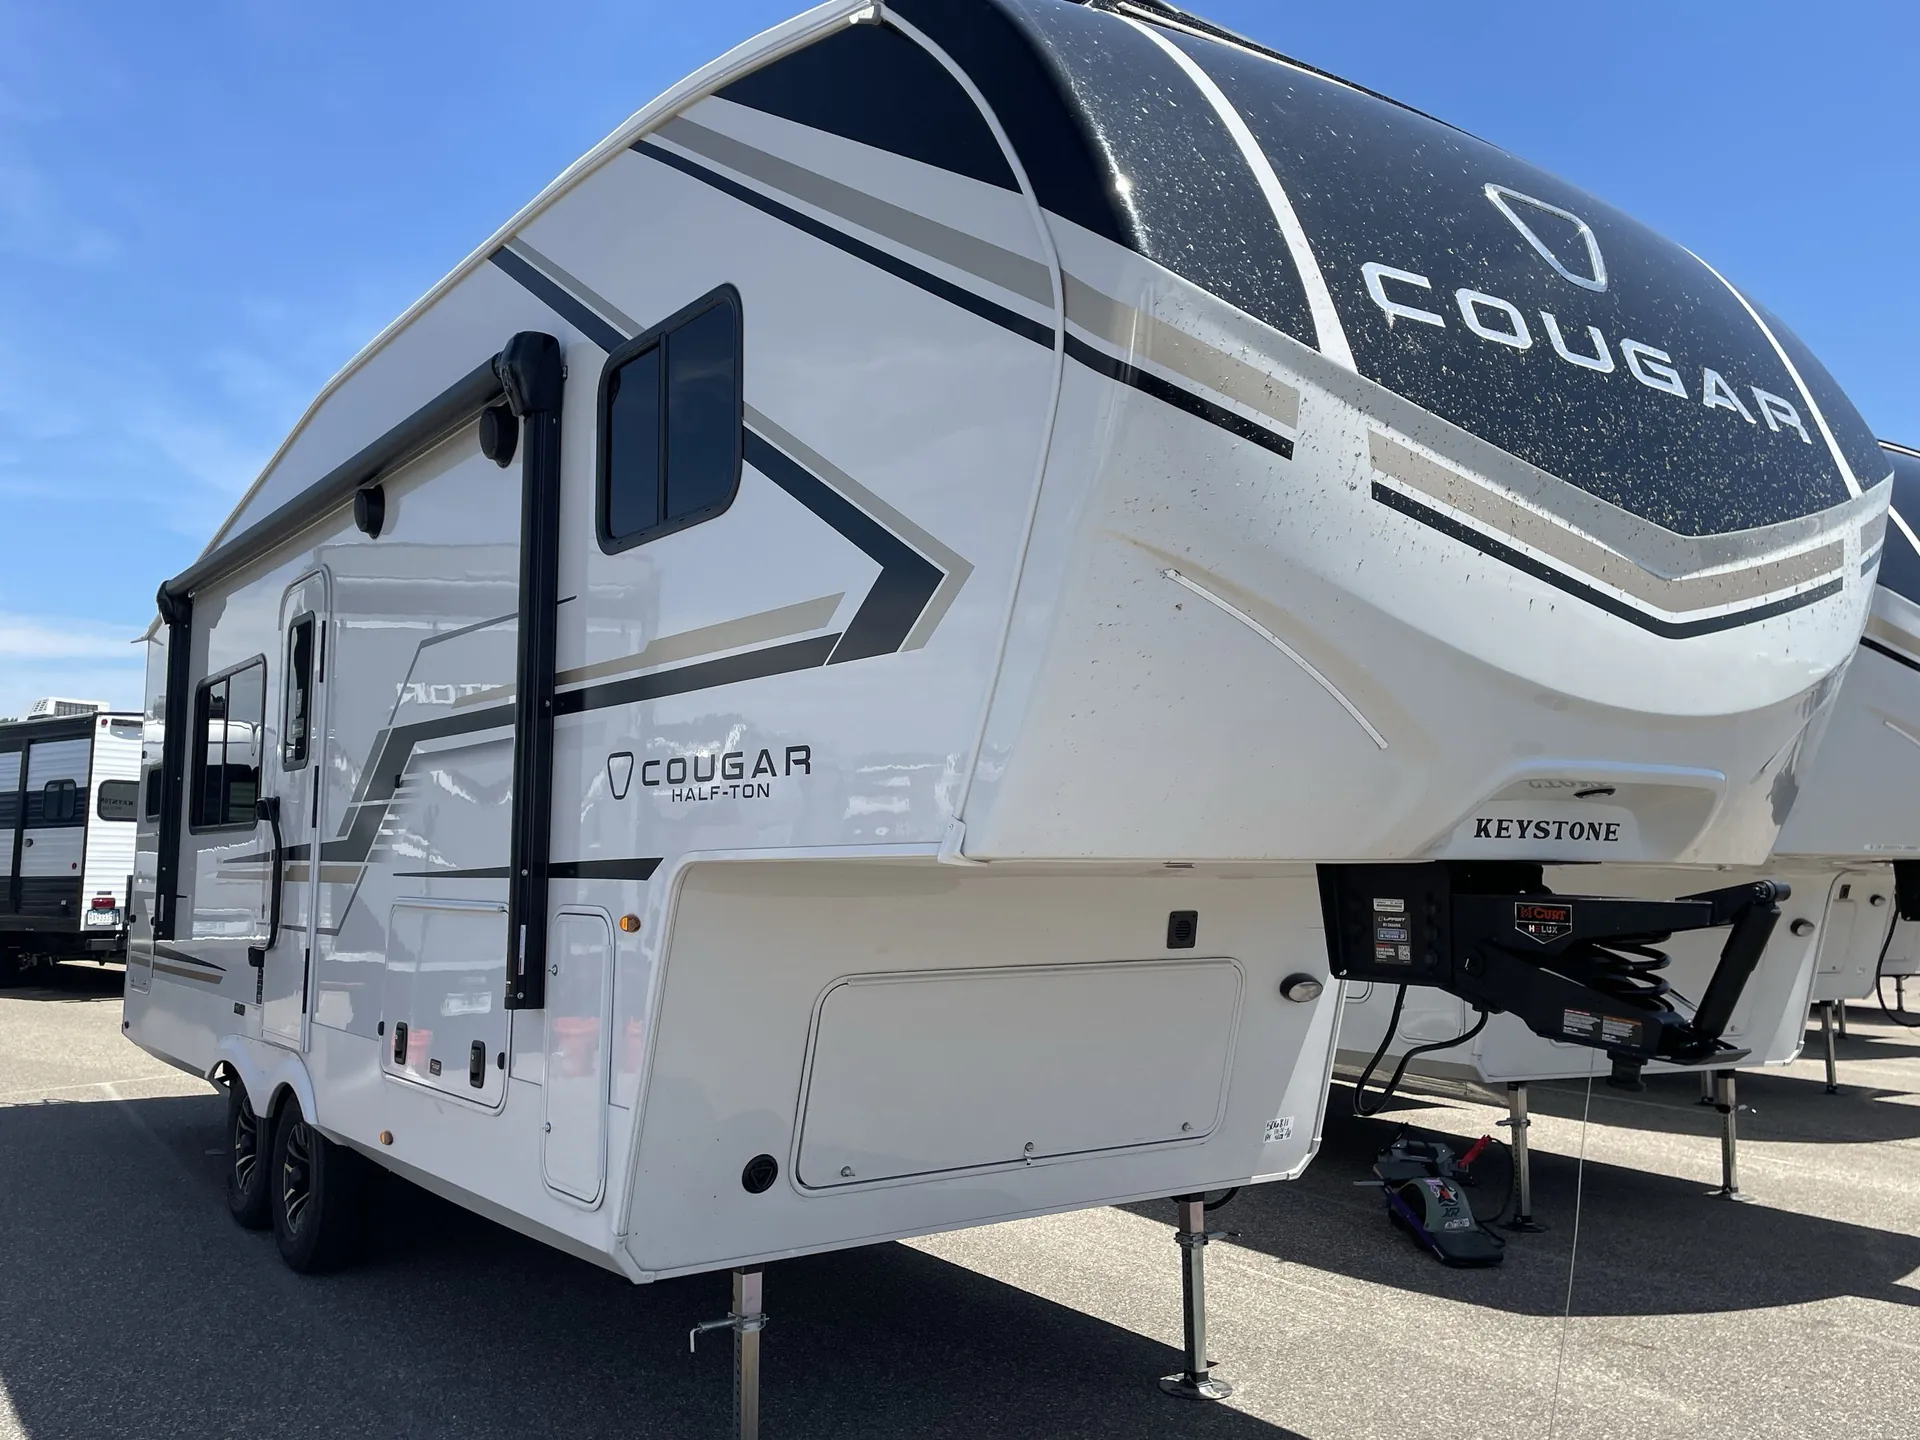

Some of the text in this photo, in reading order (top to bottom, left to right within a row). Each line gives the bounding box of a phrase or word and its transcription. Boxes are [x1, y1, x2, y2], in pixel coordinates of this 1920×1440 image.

[1361, 261, 1812, 446] COUGAR
[641, 744, 812, 787] COUGAR
[671, 782, 771, 803] HALF-TON
[1473, 817, 1621, 842] KEYSTONE
[1534, 906, 1567, 921] CURT
